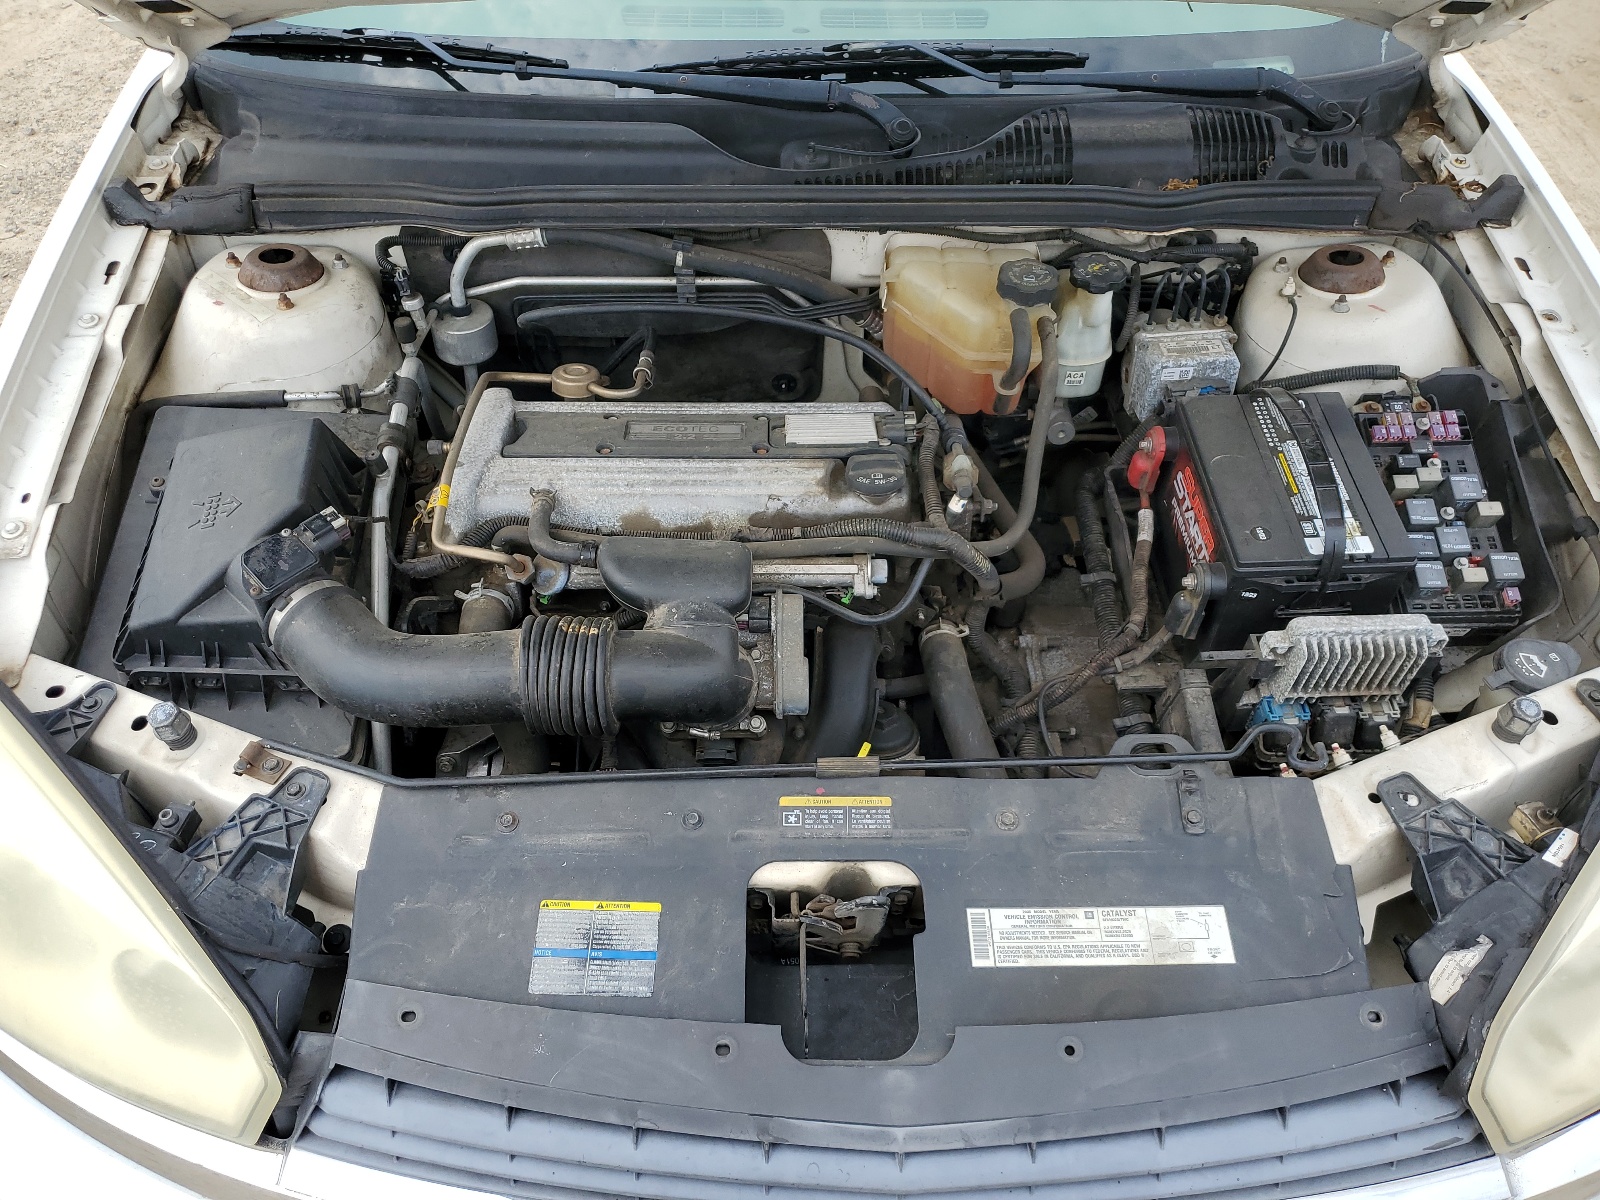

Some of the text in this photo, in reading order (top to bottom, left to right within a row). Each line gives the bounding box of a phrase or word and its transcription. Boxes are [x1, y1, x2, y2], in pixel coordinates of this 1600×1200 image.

[1066, 372, 1084, 380] ACA
[653, 425, 719, 433] ECOTEC
[856, 476, 871, 485] SAE
[1184, 465, 1215, 557] SUPER
[1173, 470, 1211, 563] START
[1170, 496, 1198, 566] PREMIUM
[1101, 909, 1137, 917] CATALYST
